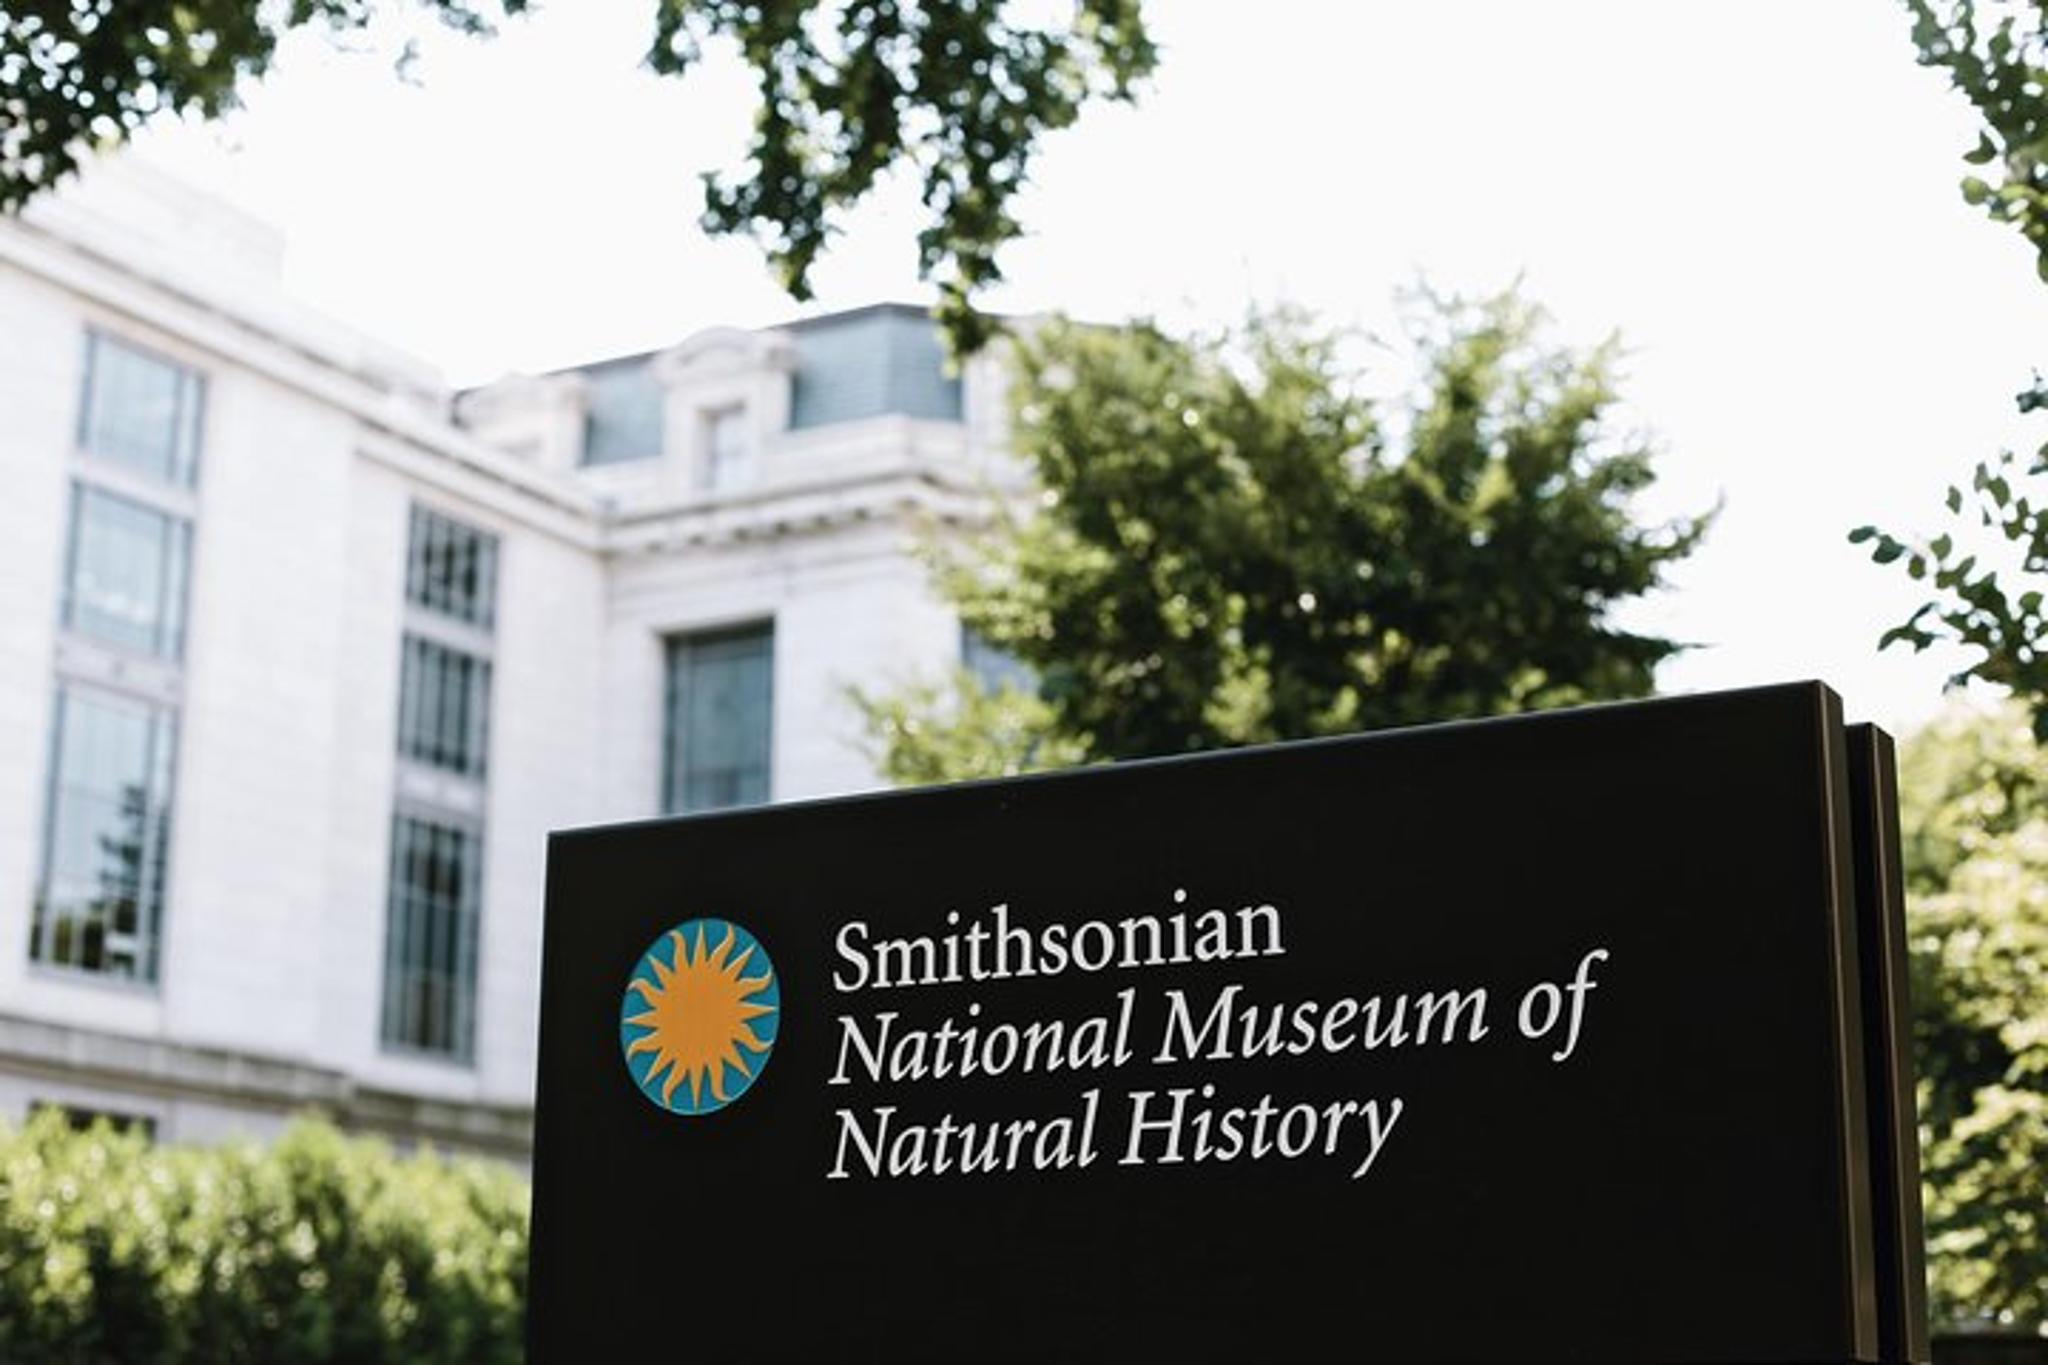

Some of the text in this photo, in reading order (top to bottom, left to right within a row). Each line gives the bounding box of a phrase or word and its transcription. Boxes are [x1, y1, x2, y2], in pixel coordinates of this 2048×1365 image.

[833, 889, 1286, 991] Smithsonian
[827, 949, 1609, 1085] National Museum of
[826, 1084, 1403, 1179] Natural History
